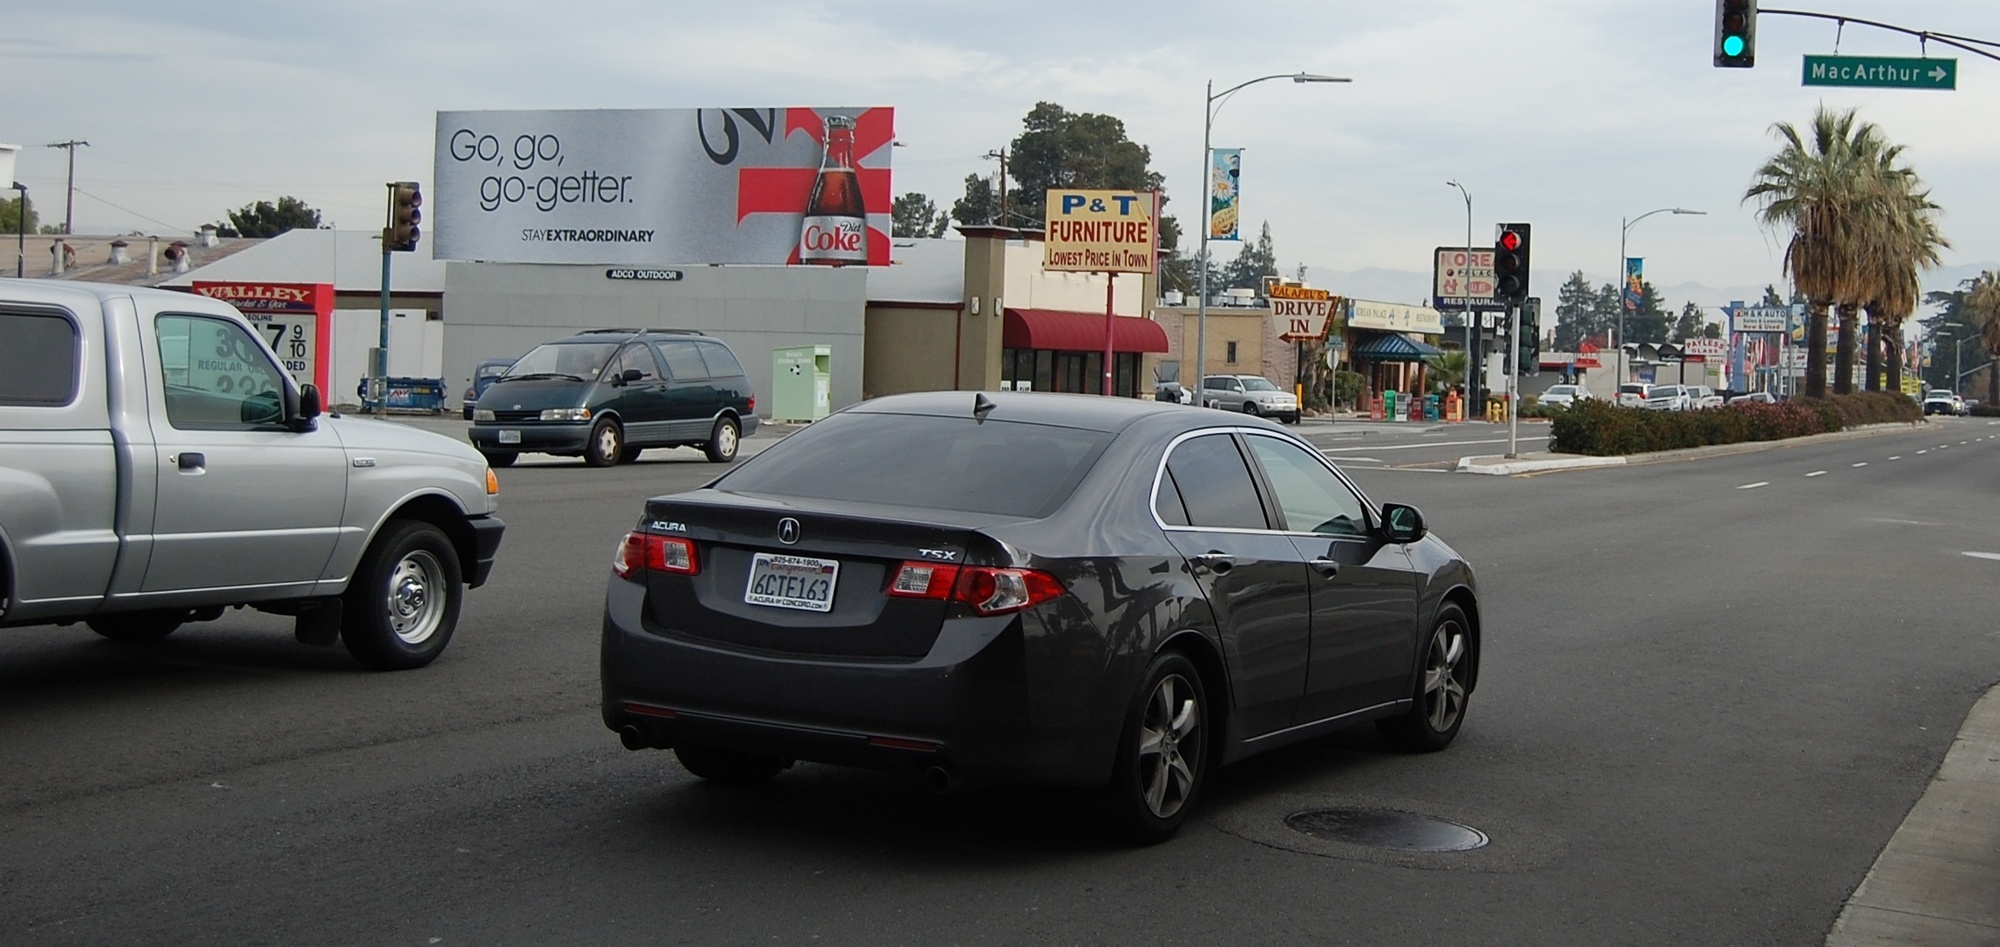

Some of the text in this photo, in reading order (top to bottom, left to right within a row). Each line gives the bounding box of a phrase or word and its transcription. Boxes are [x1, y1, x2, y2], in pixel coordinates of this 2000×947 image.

[450, 129, 564, 170] Go, go,
[479, 170, 634, 212] go-getter.
[840, 220, 862, 233] Diet
[1050, 220, 1148, 243] FURNITURE
[804, 224, 862, 252] Coke
[611, 269, 677, 280] ADCO OUTDOOR
[198, 285, 311, 302] VALLEY
[1274, 300, 1326, 316] DRIVE
[1757, 309, 1763, 318] K
[1764, 310, 1786, 318] AUTO
[1290, 319, 1309, 333] IN
[289, 343, 306, 358] 10
[1686, 340, 1725, 349] PAYLESS
[198, 360, 243, 372] REGULAR
[651, 520, 687, 533] ACURA
[918, 548, 957, 560] TSX
[754, 574, 829, 602] 6CTE163
[754, 596, 775, 604] ACURA
